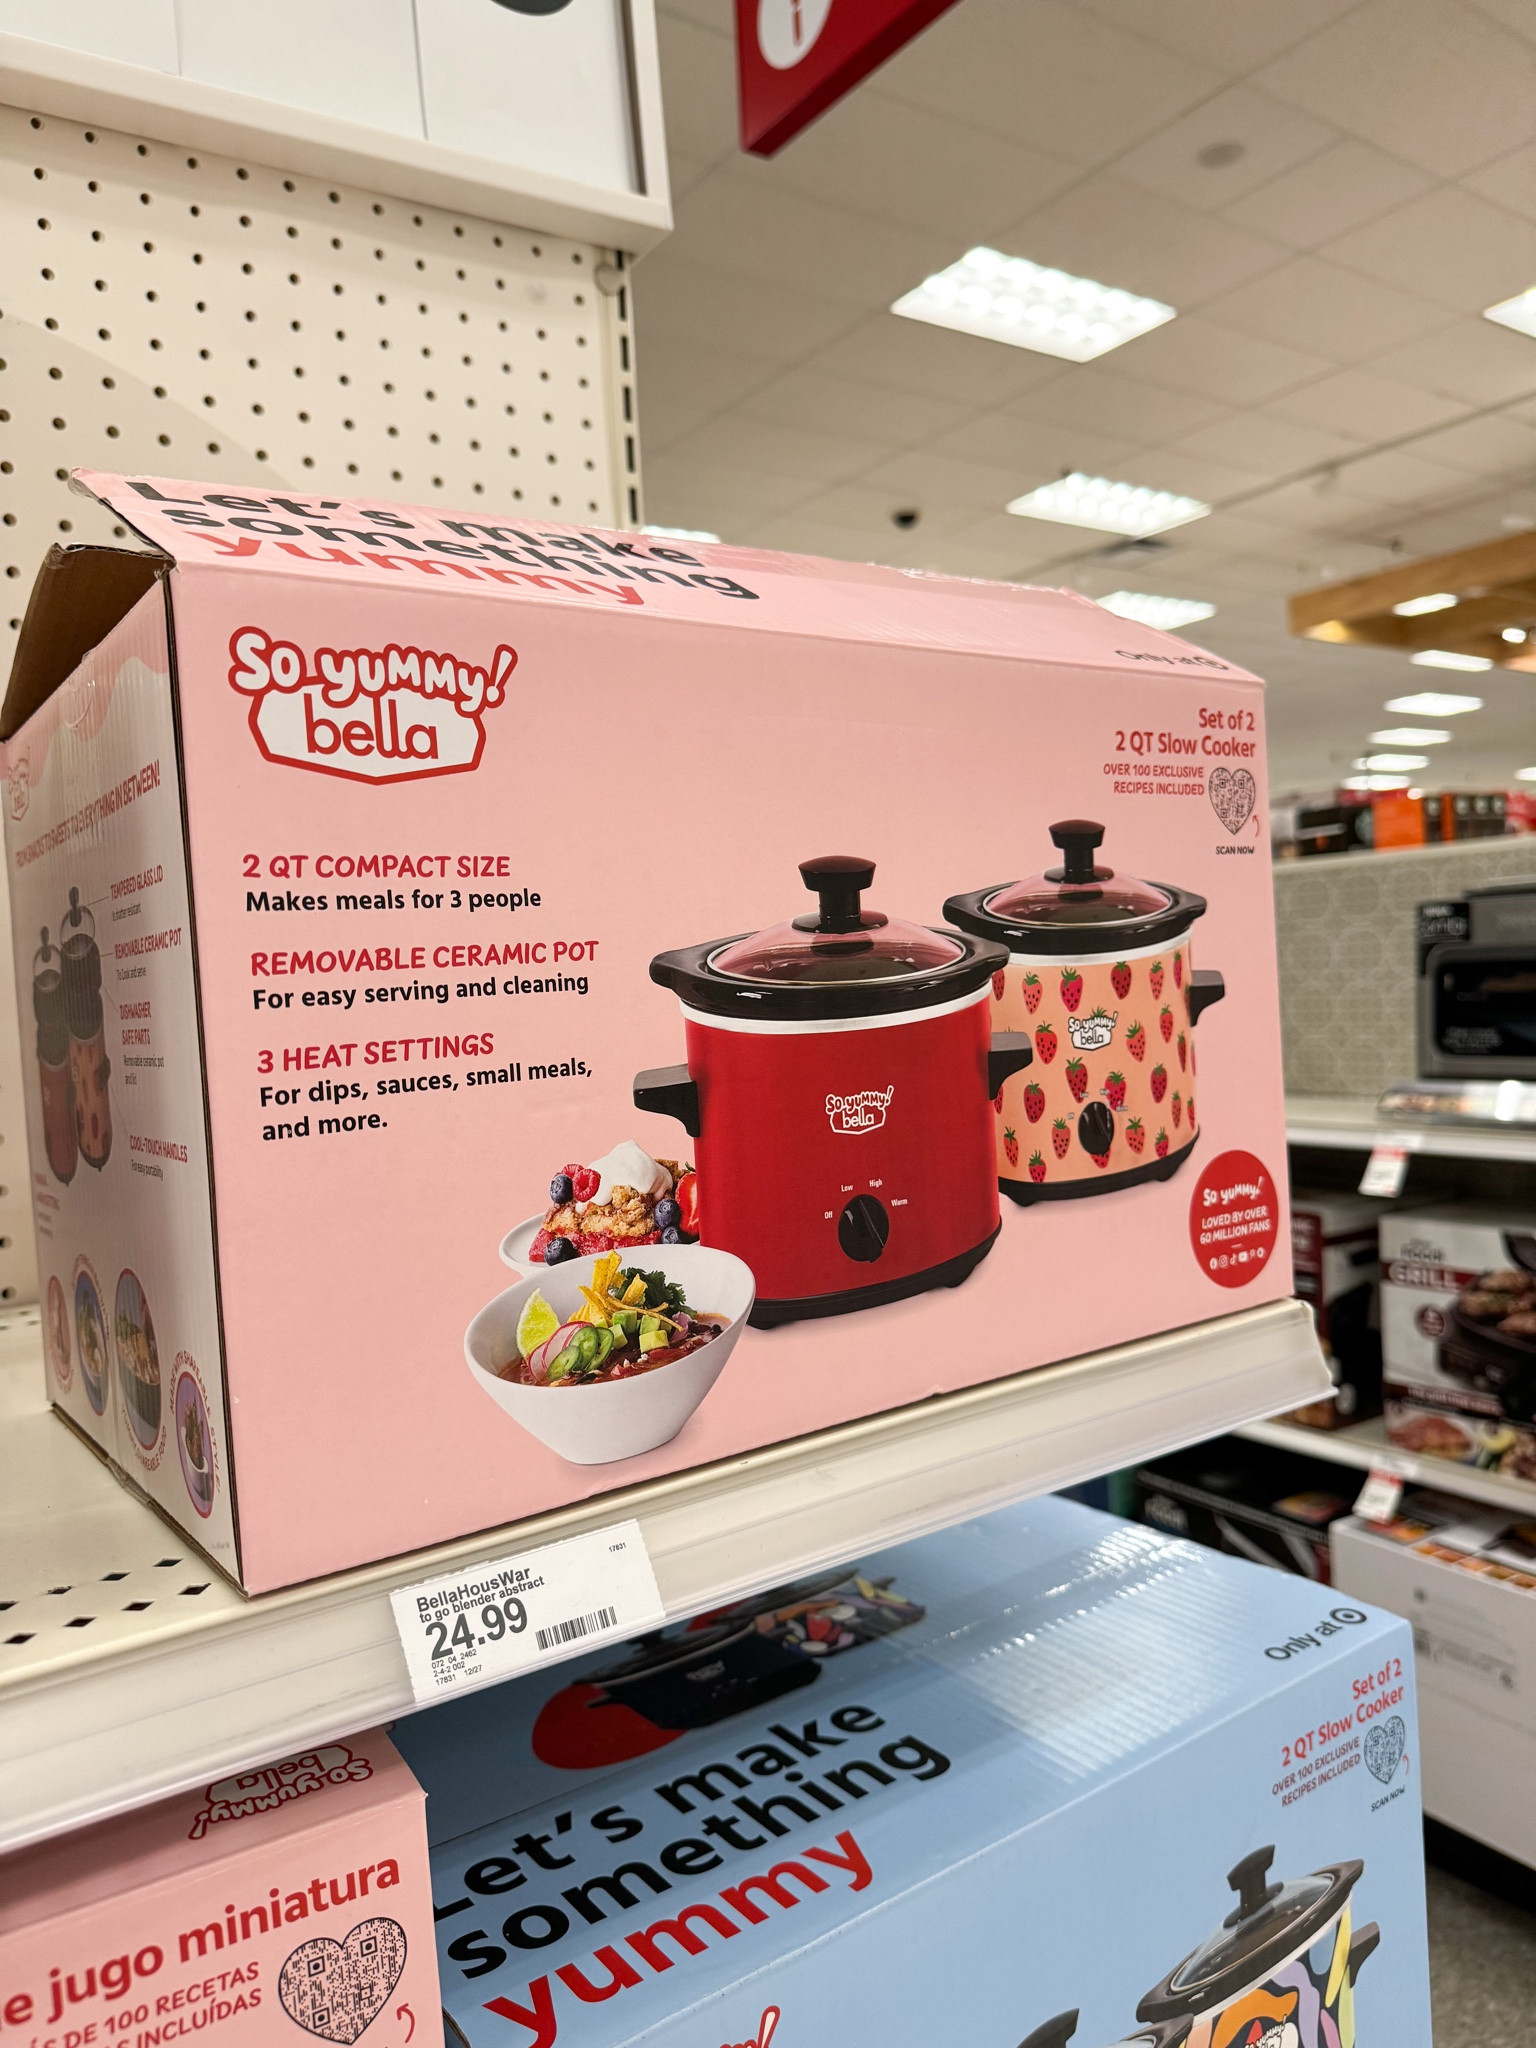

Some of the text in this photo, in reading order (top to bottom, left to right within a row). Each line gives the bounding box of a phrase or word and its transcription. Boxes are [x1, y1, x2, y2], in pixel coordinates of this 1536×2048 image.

[125, 482, 705, 567] Let's make
[161, 509, 760, 599] something
[183, 531, 644, 605] yummy
[230, 627, 305, 694] So
[303, 693, 439, 760] bella
[1199, 708, 1255, 732] Set of 2
[1115, 730, 1256, 758] 2 QT Slow Cooker
[1103, 763, 1204, 778] OVER 100 EXCLUSIVE
[1114, 781, 1205, 796] RECIPES INCLUDED
[1215, 846, 1255, 855] SCAN NOW
[137, 868, 153, 891] GLASS
[153, 864, 163, 884] LID
[242, 854, 511, 879] 2 QT COMPACT SIZE
[246, 888, 542, 912] Makes meals for 3 people
[144, 931, 169, 953] CERAMIC
[169, 927, 182, 947] POT
[251, 940, 600, 977] REMOVABLE CERAMIC POT
[253, 972, 589, 1010] For easy serving and cleaning
[134, 1028, 151, 1045] PARTS
[1080, 1027, 1104, 1044] bella
[256, 1032, 494, 1074] 3 HEAT SETTINGS
[260, 1057, 593, 1107] For dips, sauces, small meals,
[826, 1094, 842, 1114] So
[842, 1108, 875, 1128] bella
[262, 1112, 388, 1141] and more.
[841, 1184, 853, 1192] Low
[869, 1179, 883, 1188] High
[1203, 1187, 1217, 1206] So
[824, 1211, 833, 1219] Off
[891, 1198, 908, 1207] Warm
[1200, 1219, 1270, 1244] 60 MILLION FANS
[1202, 1206, 1267, 1229] LOVED BY OVER
[416, 1567, 531, 1612] BellaHousWar
[419, 1576, 545, 1624] to go blender abstract
[425, 1597, 528, 1661] 24.99
[1264, 1620, 1343, 1661] Only at
[431, 1659, 445, 1669] 072
[448, 1655, 457, 1664] 04
[433, 1661, 465, 1677] 2-4-2 002
[436, 1664, 482, 1686] 17831 12/27
[1352, 1658, 1402, 1700] Set of 2
[1281, 1686, 1404, 1767] 2 QT Slow Cooker
[236, 1754, 326, 1791] bella
[326, 1758, 373, 1784] So
[654, 1704, 886, 1815] make
[1272, 1736, 1360, 1795] OVER 100 EXCLUSIVE
[1281, 1753, 1361, 1808] RECIPES INCLUDED
[1371, 1785, 1406, 1813] SCAN NOW
[447, 1735, 951, 1980] something
[0, 1858, 400, 2030] e jugo miniatura
[482, 1830, 873, 2048] yummy
[103, 2004, 150, 2035] 100
[156, 1961, 260, 2017] RECETAS
[136, 1987, 262, 2048] INCLUÍDAS
